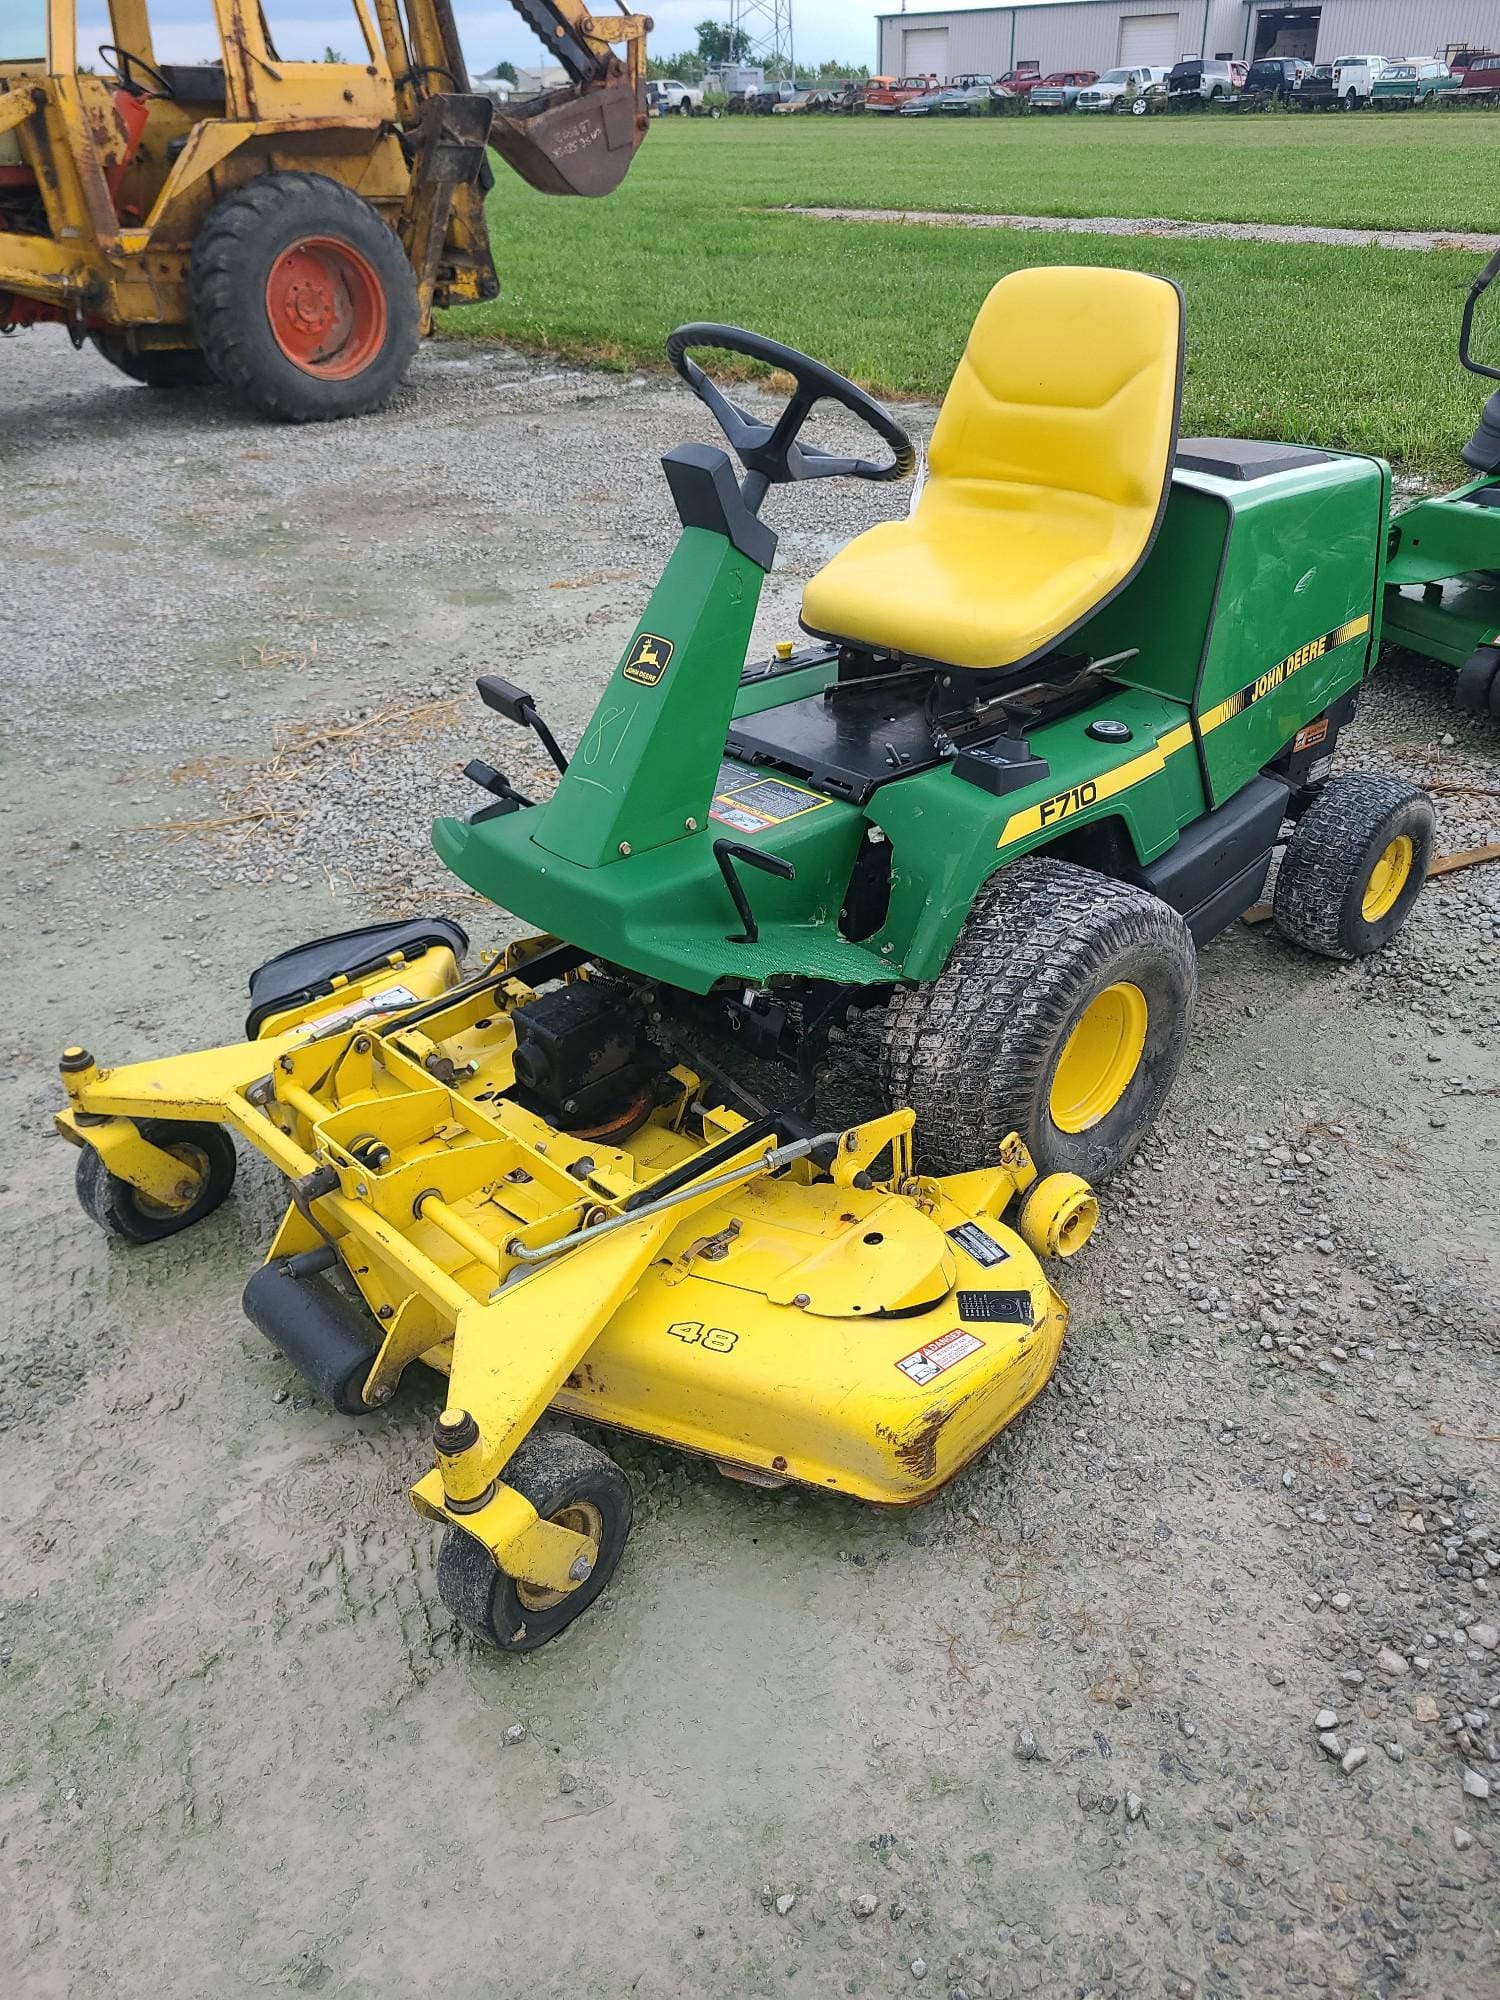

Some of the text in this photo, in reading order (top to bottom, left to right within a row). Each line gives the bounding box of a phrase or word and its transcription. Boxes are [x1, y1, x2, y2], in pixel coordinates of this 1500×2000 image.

[626, 667, 656, 682] JOHN DEERE
[1251, 636, 1326, 701] JOHN DEERE
[1040, 781, 1097, 826] F710
[667, 1321, 739, 1354] 48
[929, 1329, 965, 1352] DANGER
